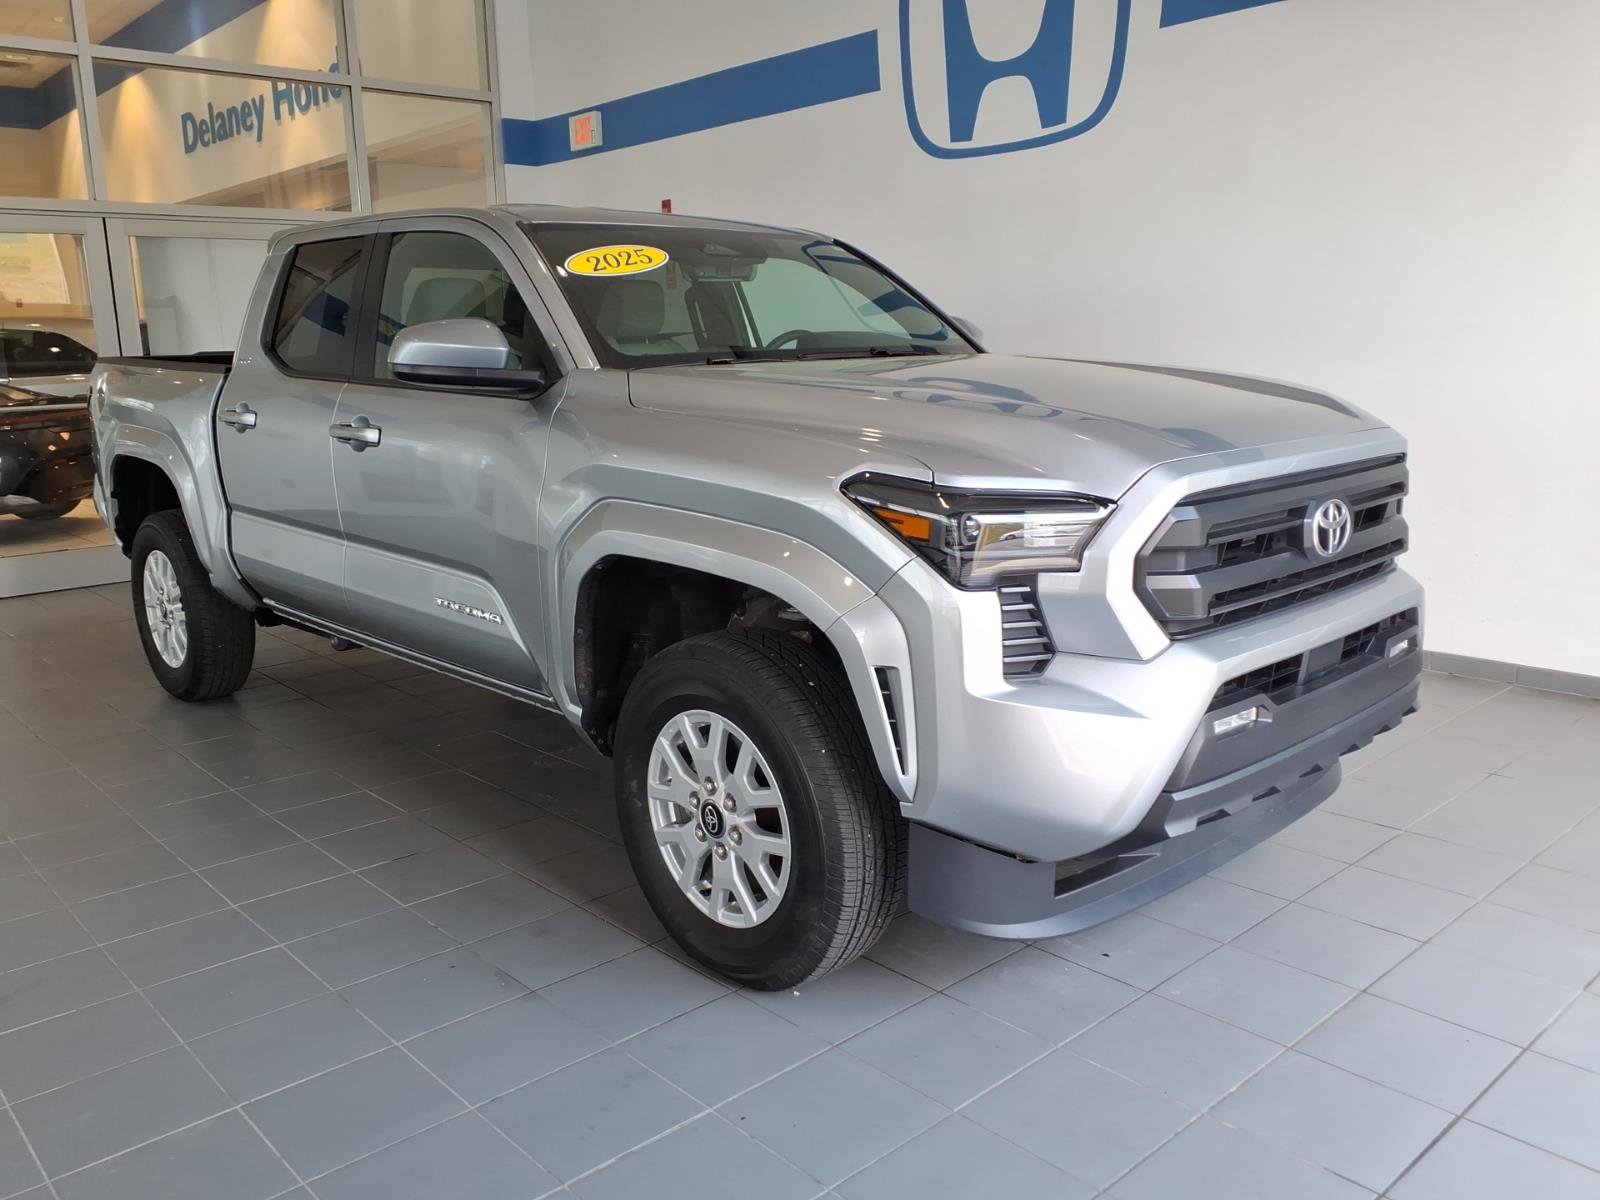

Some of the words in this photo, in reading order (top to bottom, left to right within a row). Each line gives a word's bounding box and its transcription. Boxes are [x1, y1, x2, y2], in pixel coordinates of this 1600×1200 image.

[181, 94, 265, 154] Delaney
[586, 248, 653, 272] 2025
[433, 596, 502, 625] TACOMA
